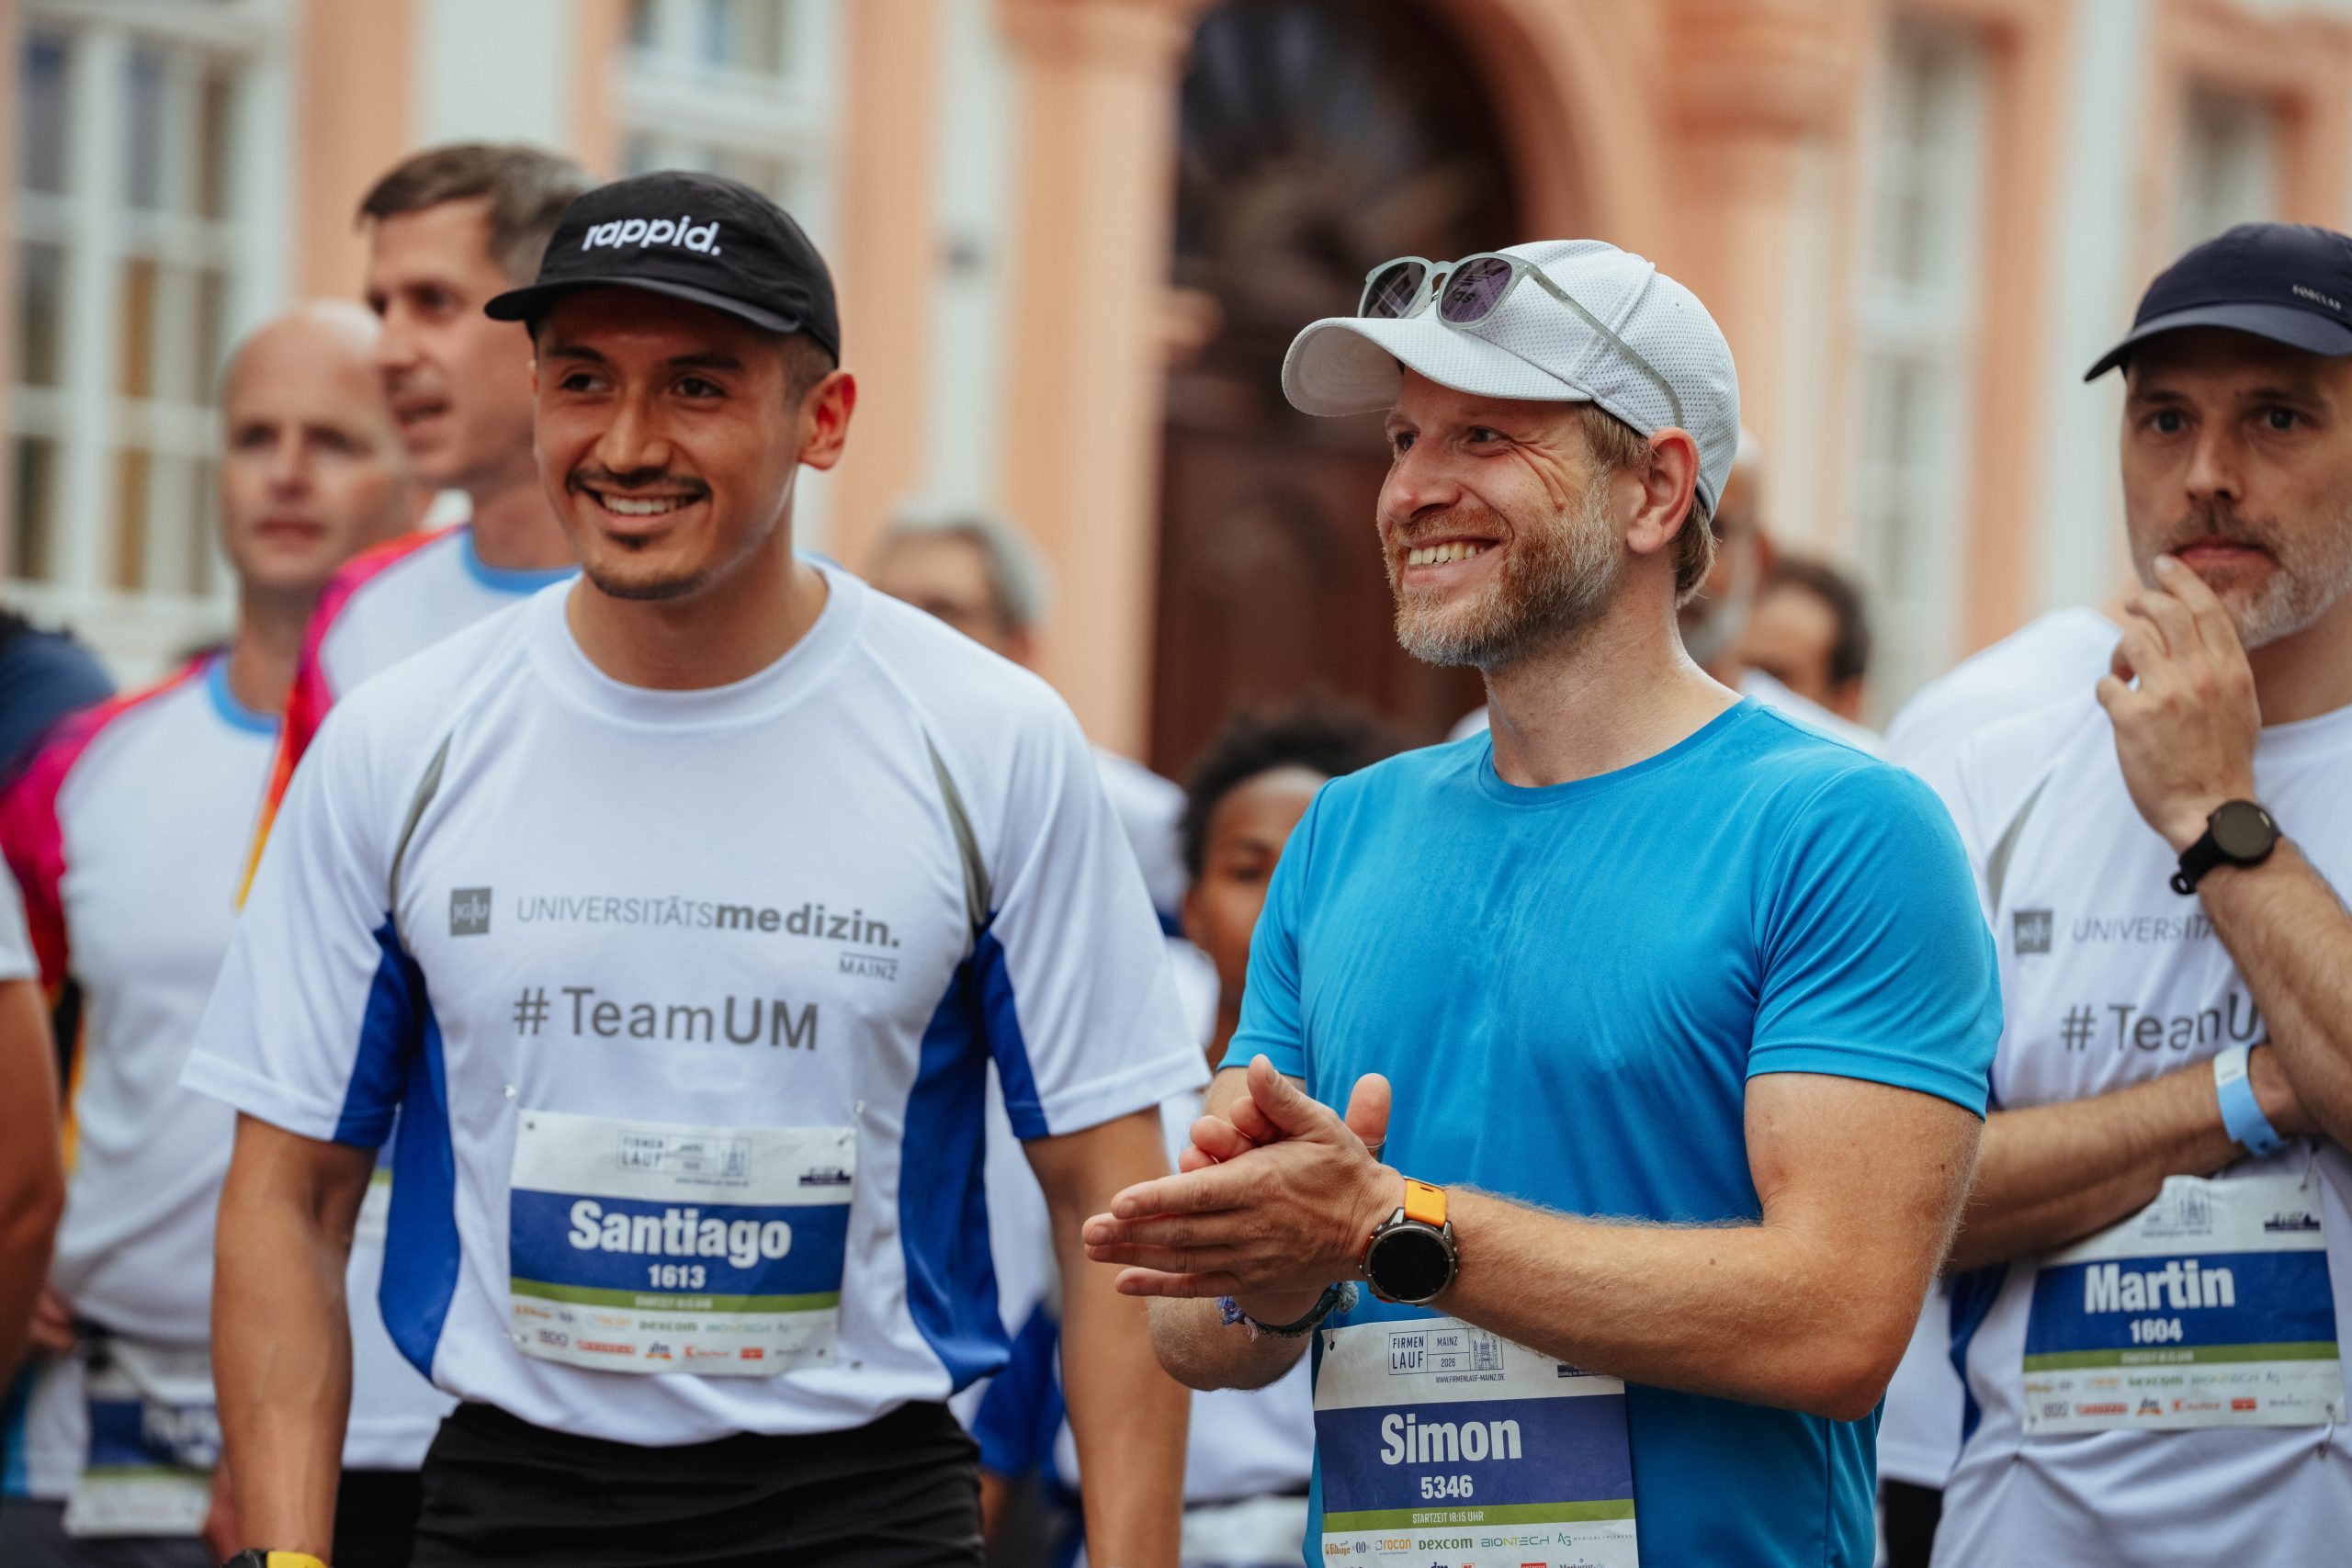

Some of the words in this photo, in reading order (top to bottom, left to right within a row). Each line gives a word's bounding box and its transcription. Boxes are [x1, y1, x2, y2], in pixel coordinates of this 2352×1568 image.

[582, 216, 721, 256] rappid.
[839, 956, 899, 982] MAINZ
[568, 1200, 793, 1269] Santiago
[648, 1264, 707, 1290] 1613
[2084, 1258, 2236, 1314] Martin
[1437, 1336, 1458, 1347] MAINZ
[2130, 1317, 2184, 1345] 1604
[1392, 1337, 1424, 1348] FIRMEN
[1392, 1351, 1424, 1369] LAUF
[1441, 1358, 1456, 1368] 2026
[1435, 1373, 1505, 1383] WWW.FIRMENLAUF-MAINZ.DE
[1380, 1413, 1522, 1466] Simon
[1420, 1475, 1474, 1500] 5346
[1412, 1512, 1448, 1524] STARTZEIT
[1449, 1511, 1466, 1522] 18:15
[1467, 1510, 1485, 1522] UHR
[1383, 1539, 1411, 1551] rocon
[1481, 1535, 1550, 1548] BIONTECH
